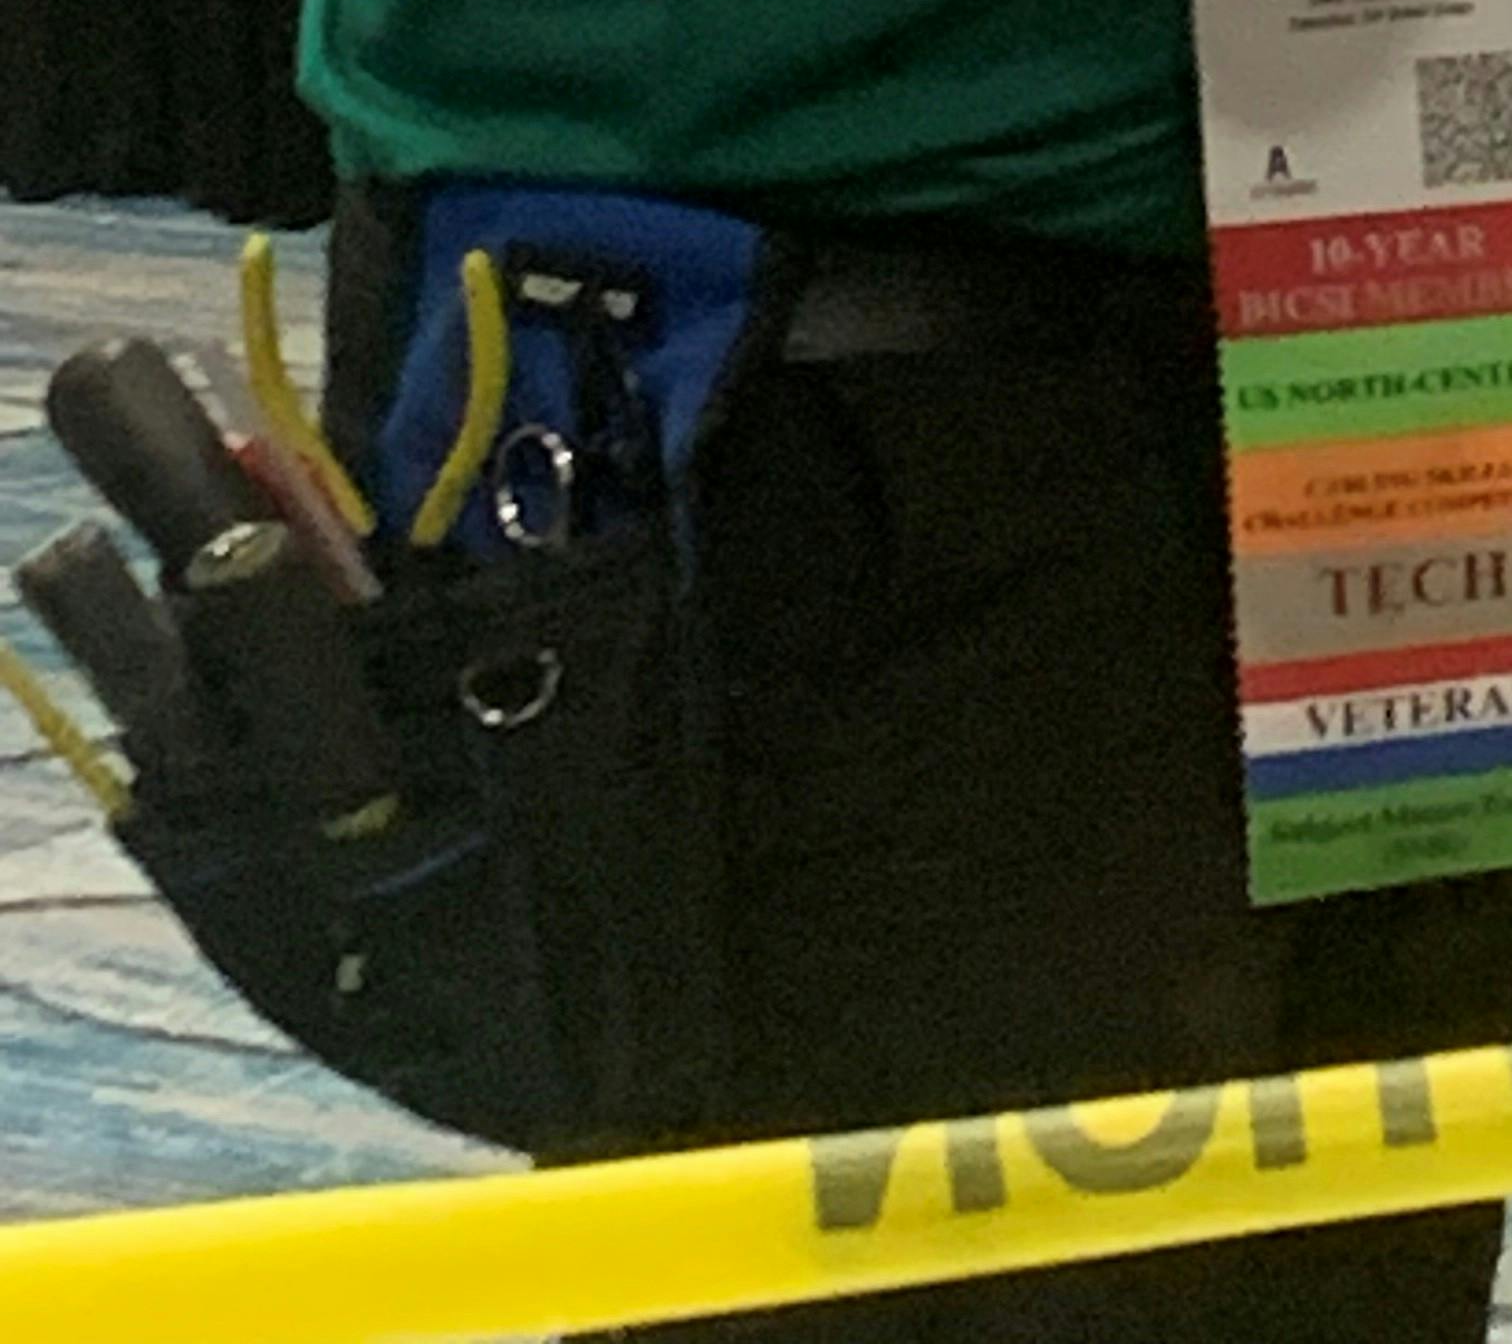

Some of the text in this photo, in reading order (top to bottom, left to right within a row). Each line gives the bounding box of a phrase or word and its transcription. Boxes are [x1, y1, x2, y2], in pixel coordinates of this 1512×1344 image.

[1238, 284, 1354, 329] BICSI
[1238, 383, 1279, 412] US
[1320, 551, 1508, 617] TECH
